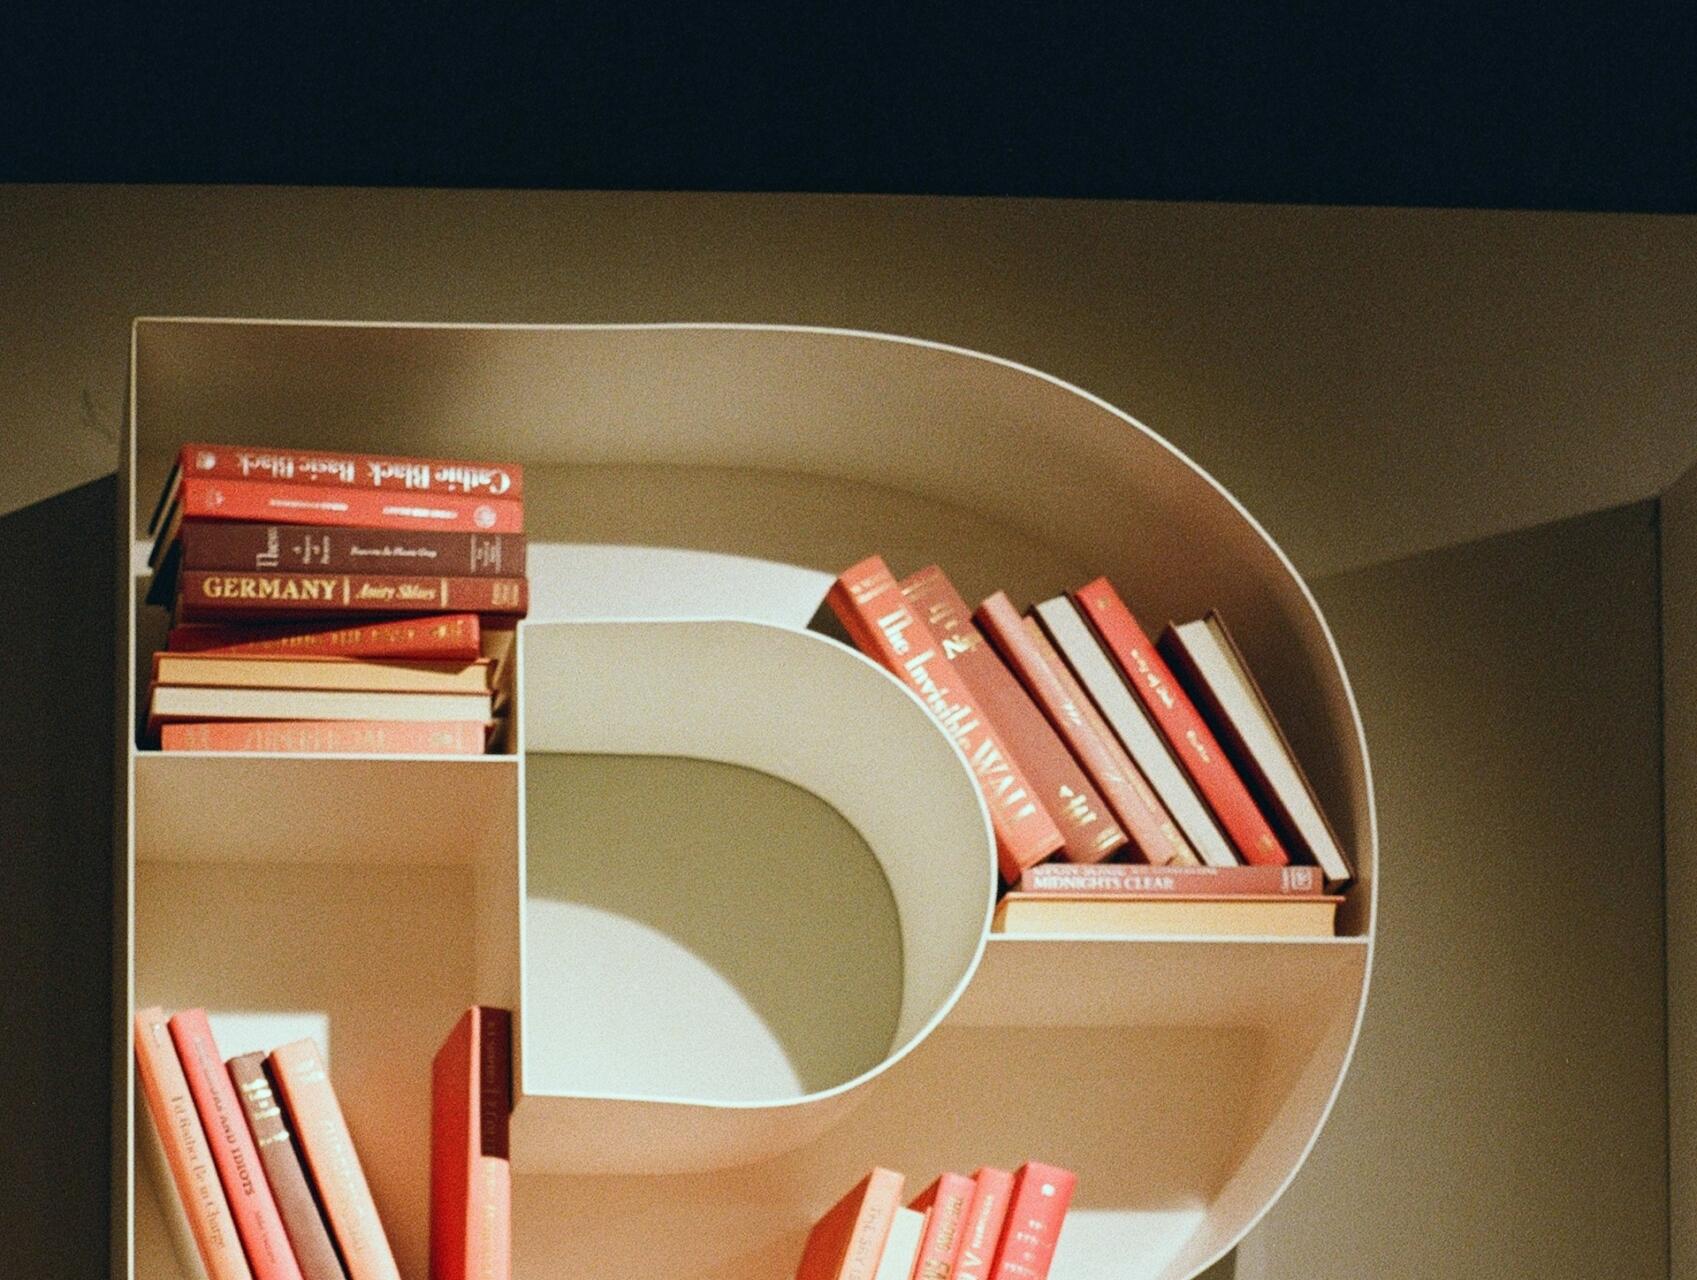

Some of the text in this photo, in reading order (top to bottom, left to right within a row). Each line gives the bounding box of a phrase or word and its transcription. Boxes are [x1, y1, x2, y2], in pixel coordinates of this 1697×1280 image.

[236, 452, 294, 477] Black
[300, 456, 356, 483] Basic
[367, 460, 431, 488] Black
[203, 576, 337, 601] GERMANY
[878, 606, 914, 654] The
[970, 737, 1038, 823] WALL
[1033, 876, 1175, 891] MIDNIGHTS CLEAR
[219, 1113, 234, 1145] AND
[230, 1147, 254, 1198] IDIOTS
[201, 1202, 226, 1250] Charge
[962, 1250, 983, 1270] A
